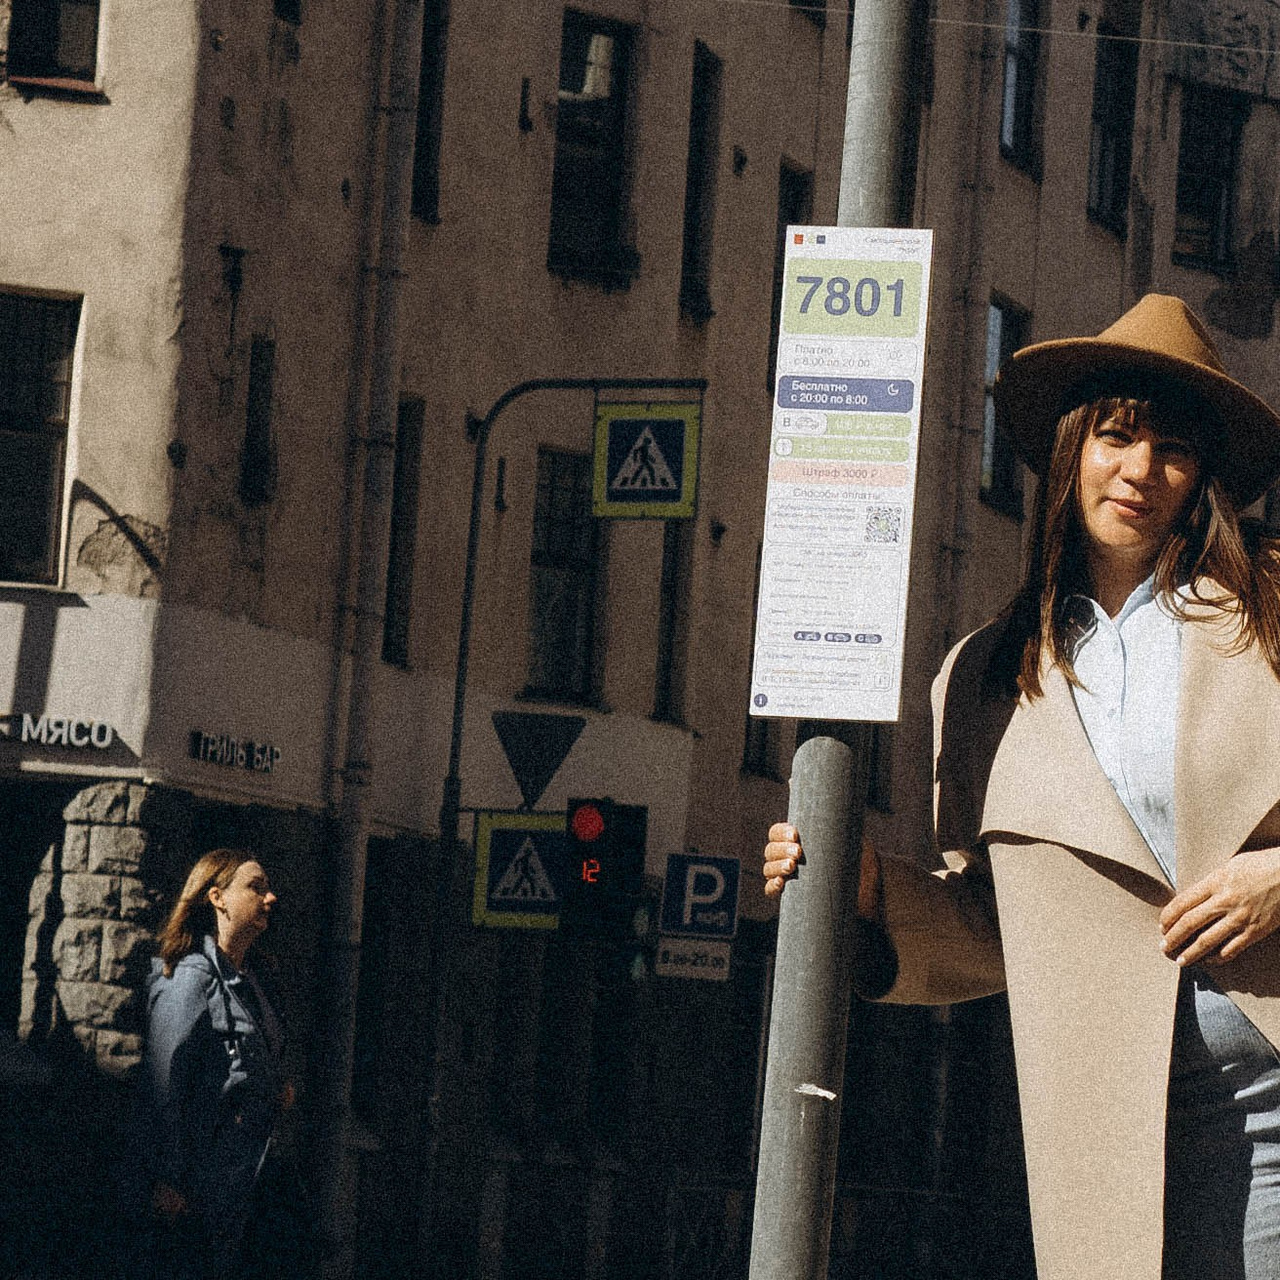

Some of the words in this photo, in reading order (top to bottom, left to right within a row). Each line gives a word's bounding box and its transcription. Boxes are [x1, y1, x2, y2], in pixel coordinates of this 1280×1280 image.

[796, 276, 904, 317] 7801
[791, 380, 848, 393] Бесплатно
[800, 393, 828, 403] 20:00
[830, 395, 844, 404] по
[845, 395, 868, 406] 8:00
[802, 467, 840, 479] Штраф
[21, 713, 113, 748] МЯСО
[194, 730, 247, 767] ГРИЛЬ
[249, 742, 282, 773] БАР
[582, 858, 600, 882] 12
[683, 864, 725, 924] P
